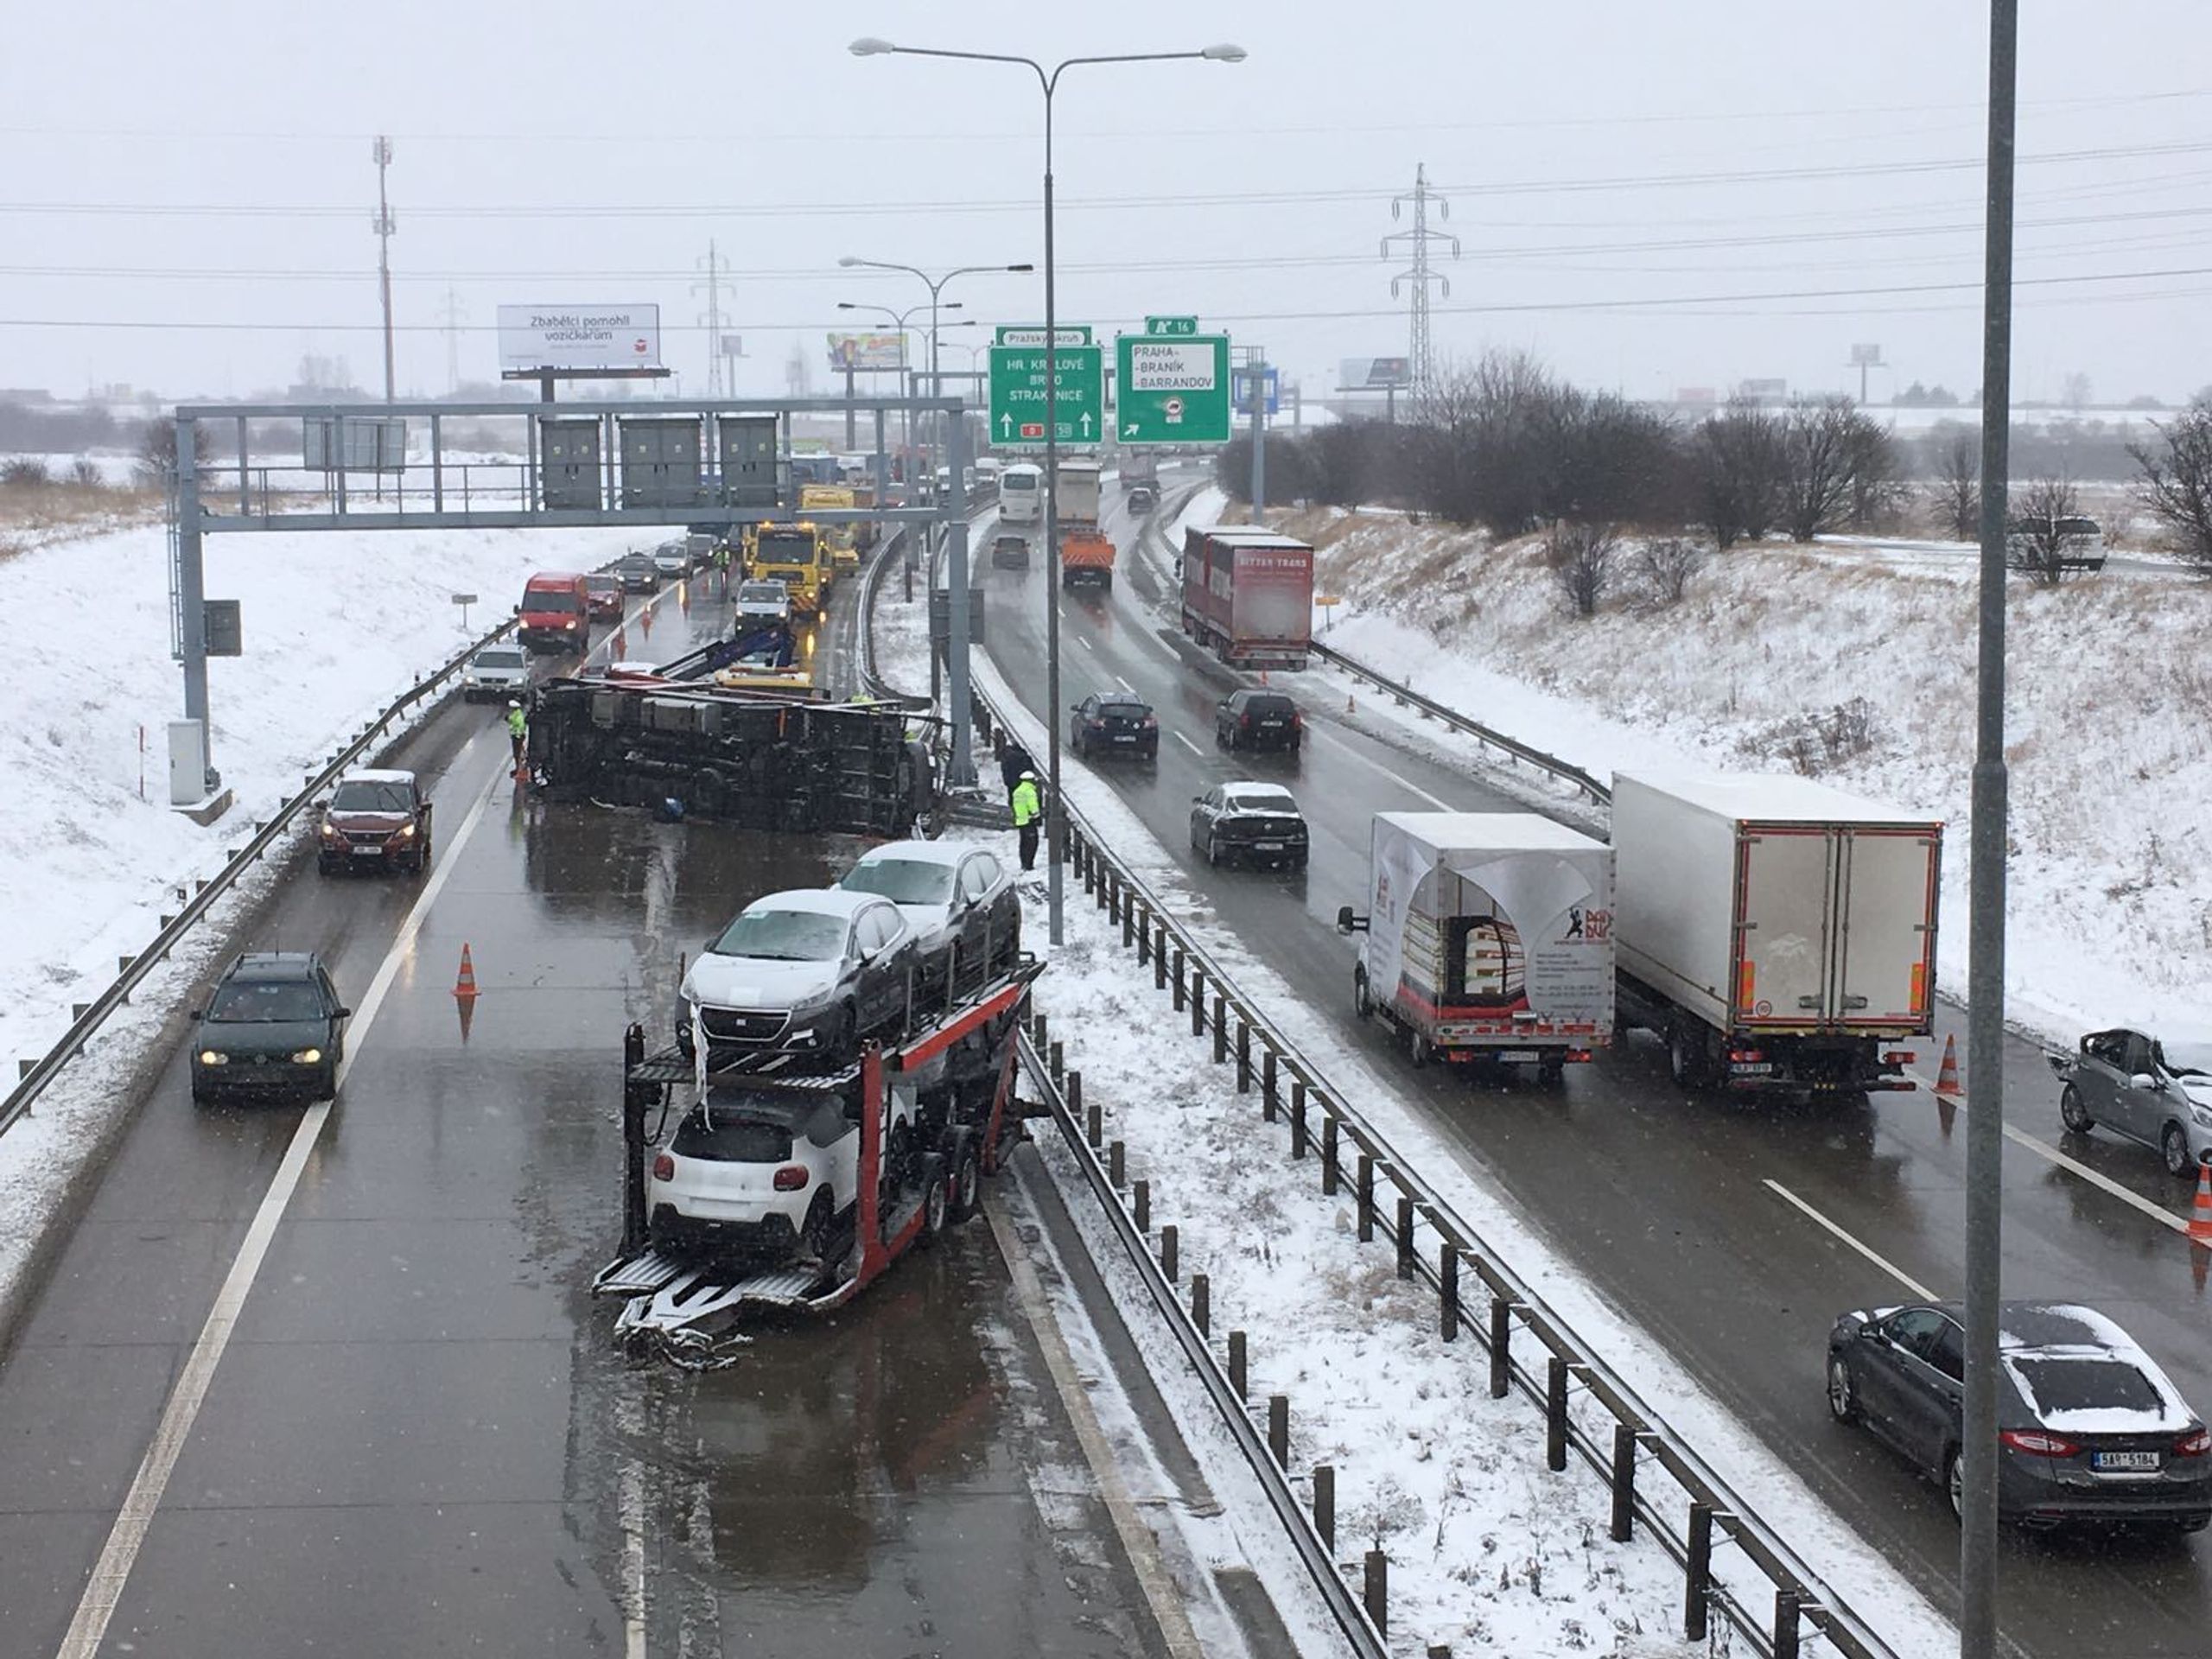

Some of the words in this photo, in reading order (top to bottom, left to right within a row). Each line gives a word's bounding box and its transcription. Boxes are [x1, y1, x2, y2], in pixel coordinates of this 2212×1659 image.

[583, 315, 630, 330] pomohli
[1031, 357, 1084, 371] KRLOVÉ
[1030, 375, 1063, 385] BRO
[1009, 390, 1084, 402] STRAKNICE
